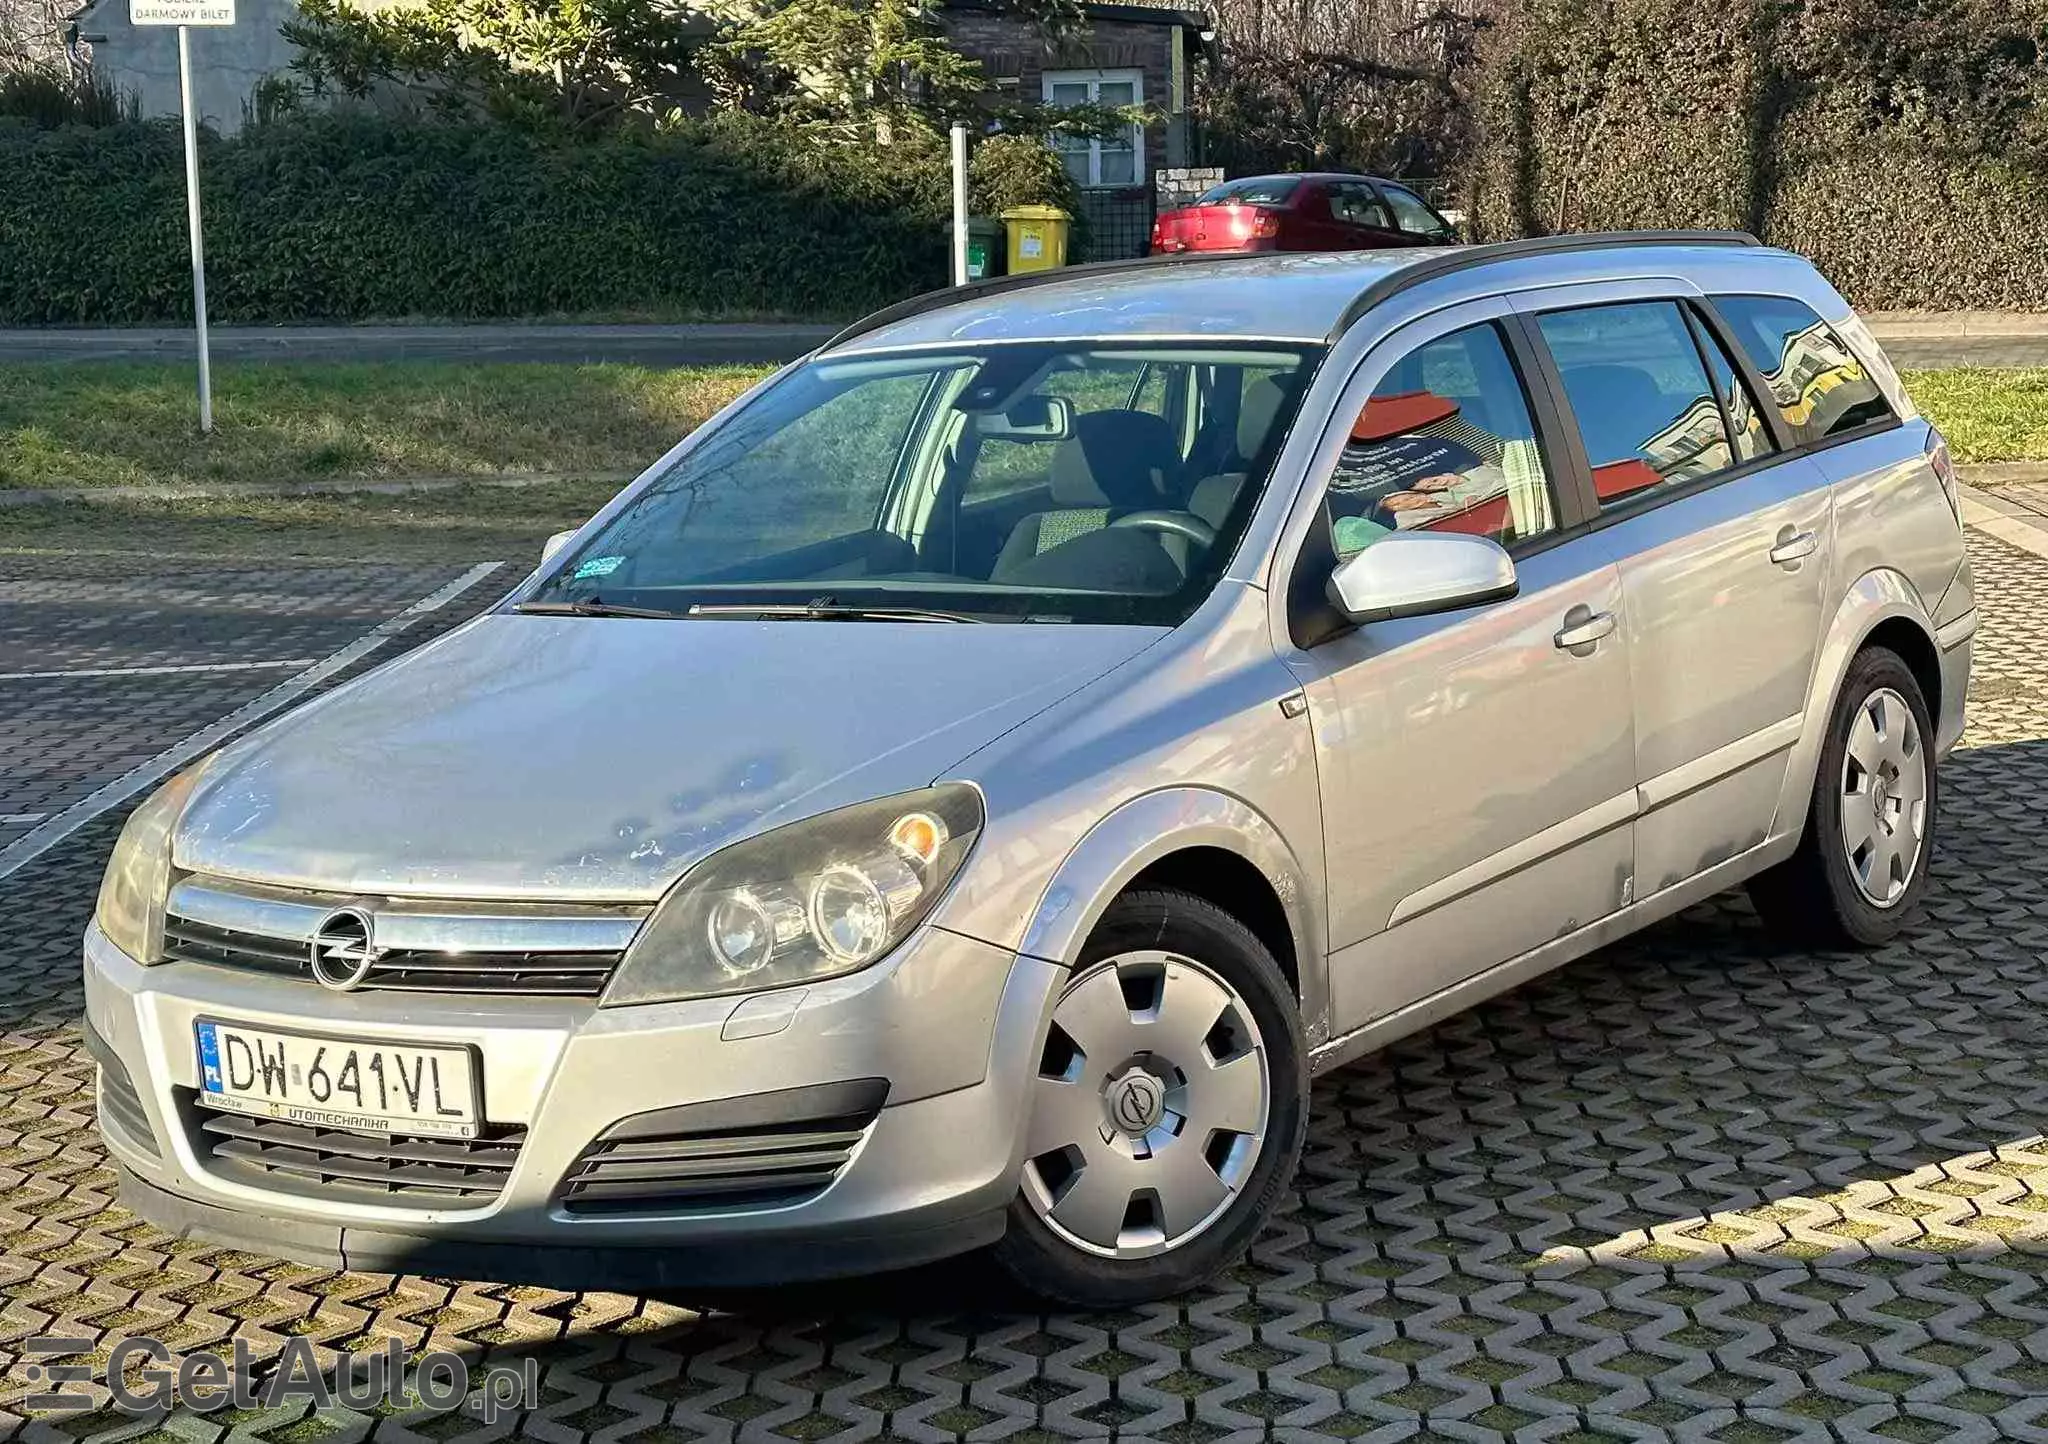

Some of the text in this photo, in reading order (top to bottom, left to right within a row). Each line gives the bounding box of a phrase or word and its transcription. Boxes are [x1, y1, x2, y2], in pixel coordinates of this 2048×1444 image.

[135, 9, 230, 19] DARMOWY BILET
[205, 1064, 222, 1083] PL
[225, 1034, 463, 1116] DW 641VL
